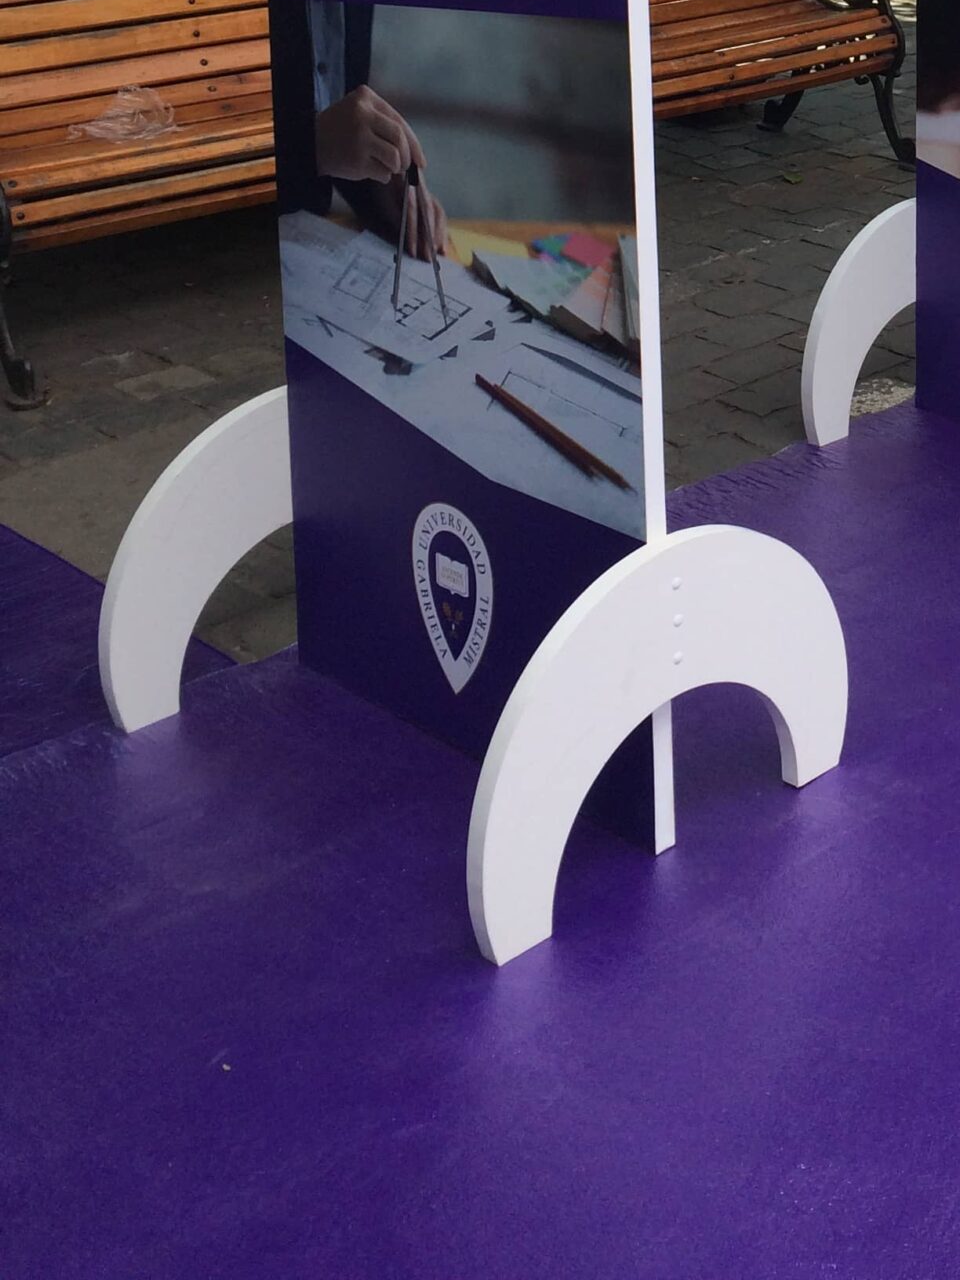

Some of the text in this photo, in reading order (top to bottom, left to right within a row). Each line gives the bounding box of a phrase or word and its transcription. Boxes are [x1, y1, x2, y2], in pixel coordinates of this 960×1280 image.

[419, 511, 486, 575] UNIVERSIDAD
[416, 559, 448, 659] GABRIELA
[463, 596, 489, 670] MISTRAL
